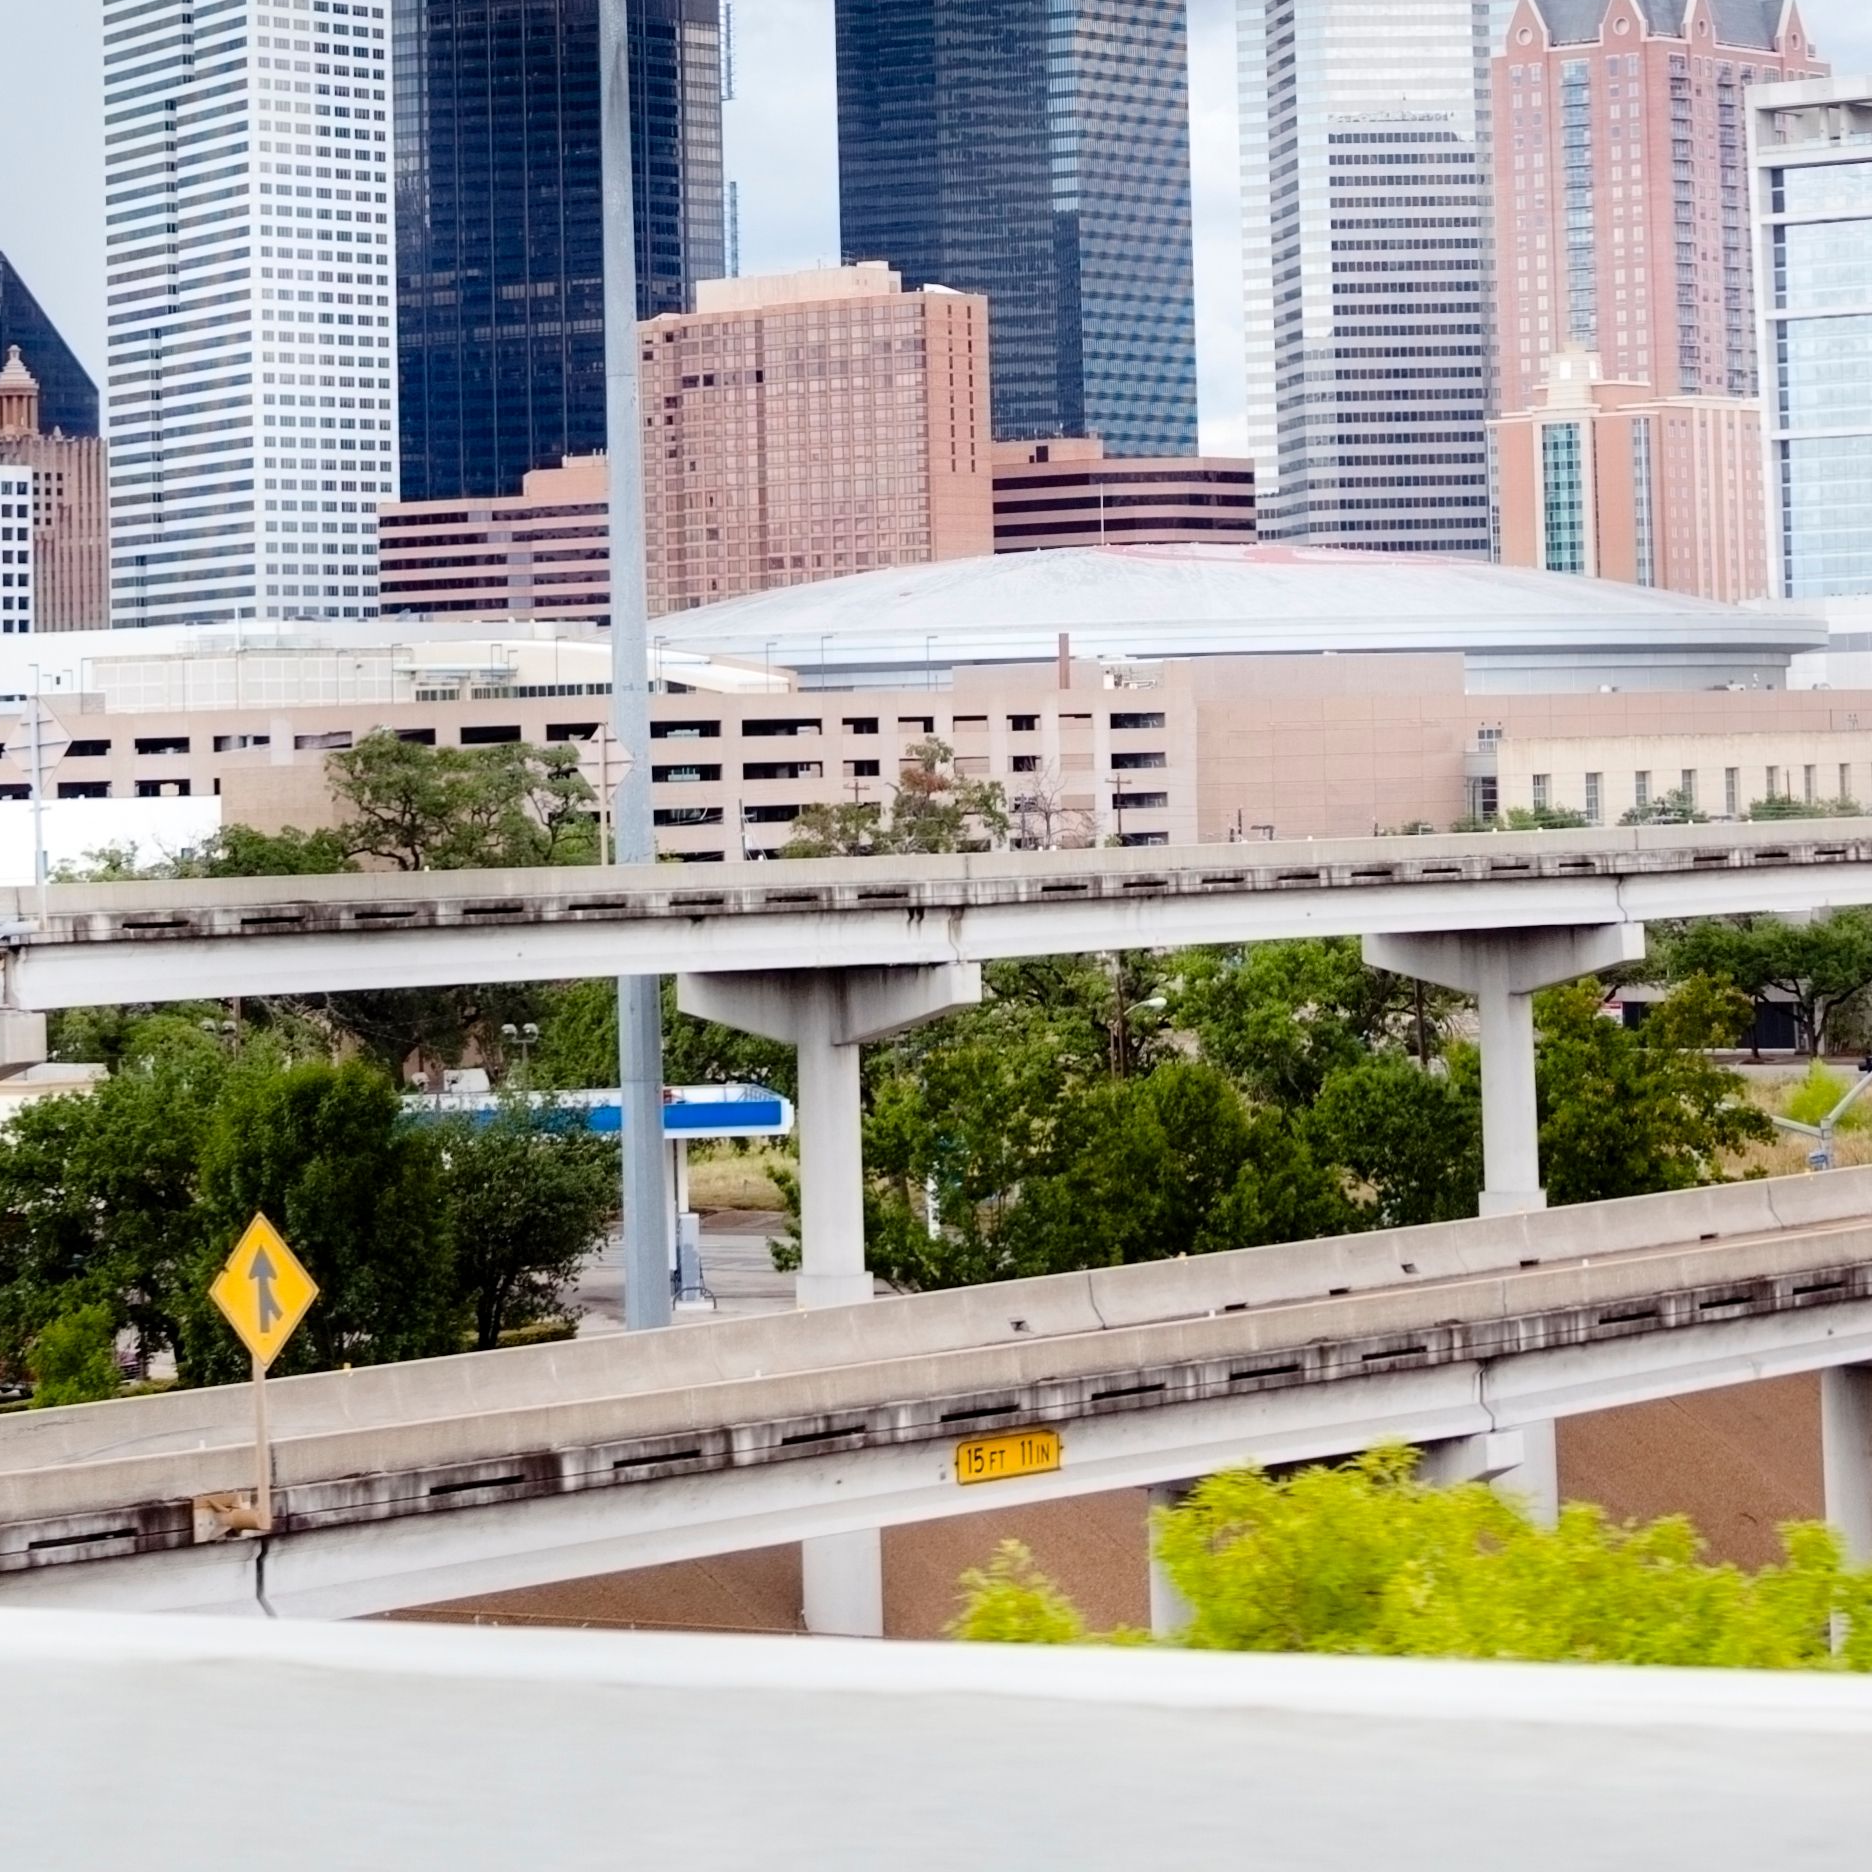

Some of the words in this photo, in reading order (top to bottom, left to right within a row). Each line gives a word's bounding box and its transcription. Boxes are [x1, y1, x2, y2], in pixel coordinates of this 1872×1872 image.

[967, 1447, 985, 1474] 15
[989, 1449, 1006, 1472] FT
[1020, 1439, 1033, 1466] 11
[1036, 1442, 1050, 1464] IN
